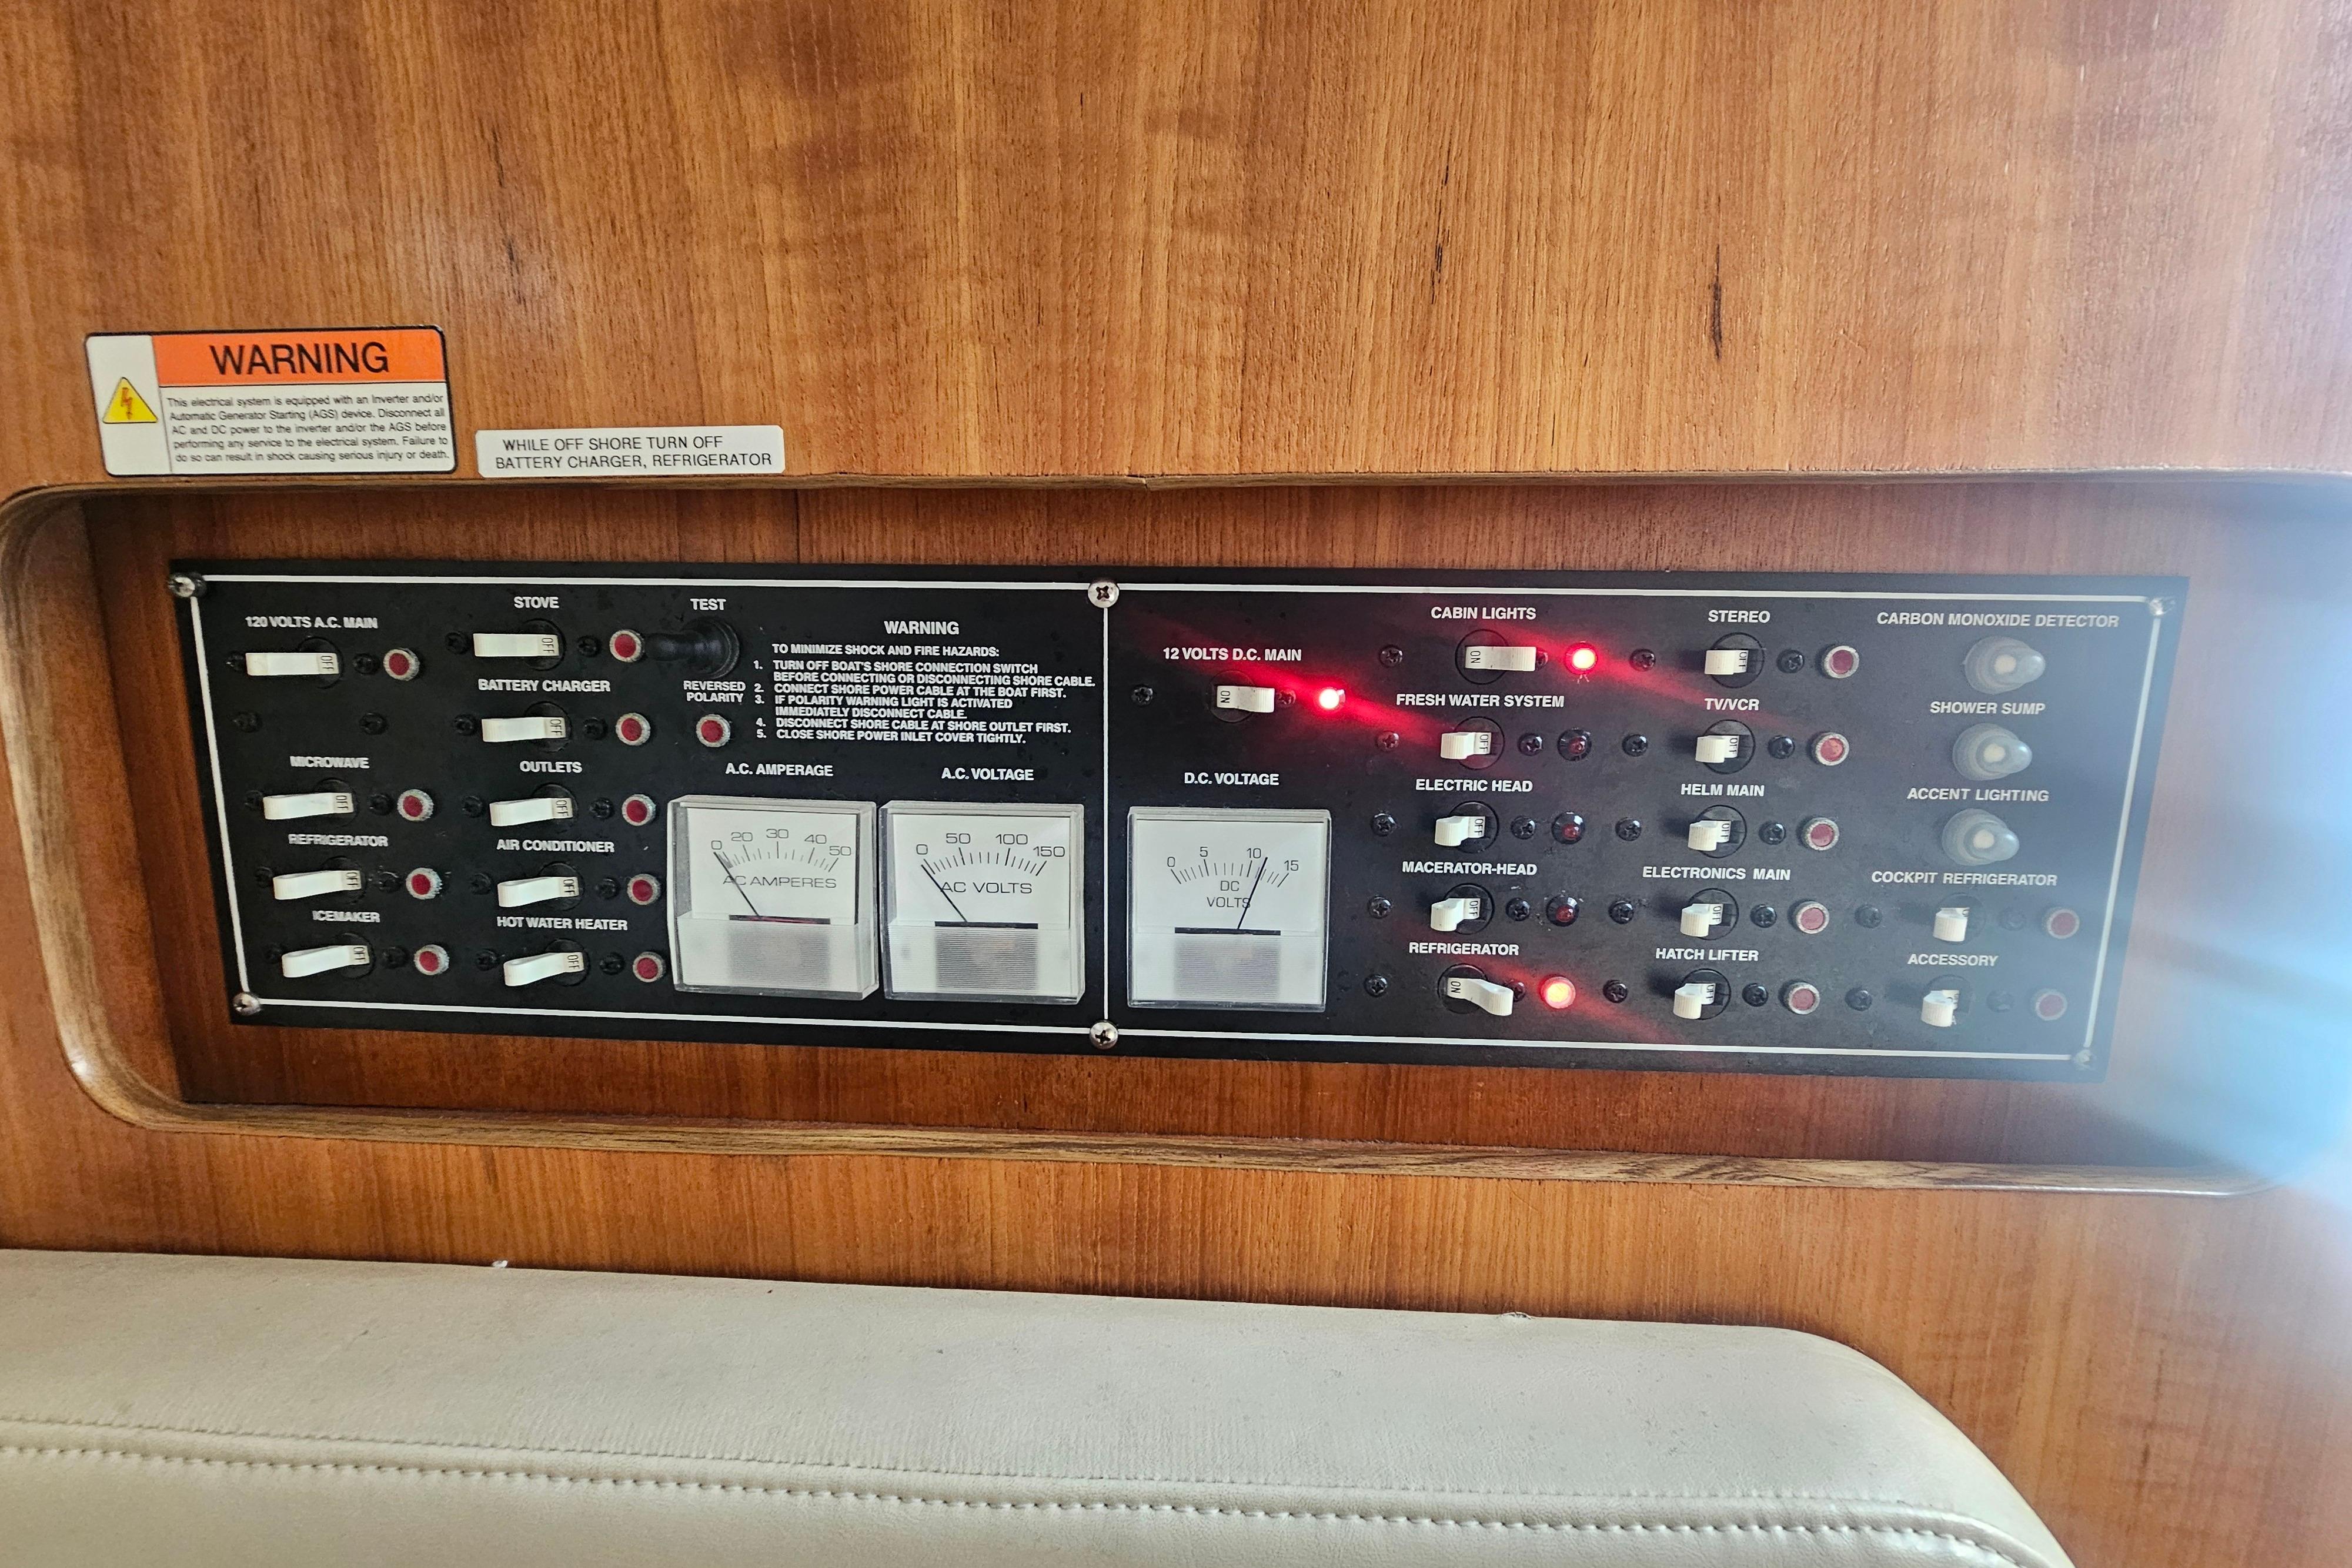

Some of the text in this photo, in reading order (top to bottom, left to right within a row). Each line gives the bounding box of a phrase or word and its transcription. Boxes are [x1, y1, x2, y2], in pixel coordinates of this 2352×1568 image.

[209, 341, 389, 375] WARNING
[166, 397, 188, 407] This
[191, 399, 233, 407] electrical
[236, 398, 270, 407] system
[285, 396, 330, 407] equipped
[333, 395, 353, 404] with
[412, 393, 444, 403] and/or
[503, 436, 723, 451] WHILE OFF SHORE TURN OFF
[496, 453, 772, 469] BATTERY CHARGER, REFRIGERATOR
[513, 596, 560, 609] STOVE
[690, 598, 727, 611] TEST
[1431, 606, 1536, 620] CABIN LIGHTS
[1708, 610, 1770, 623] STEREO
[1877, 612, 2119, 627] CARBON MONOXIDE DETECTOR
[245, 616, 378, 628] 120 VOLTS A.C. MAIN
[884, 621, 960, 635] WARNING
[771, 643, 1000, 657] TO MINIMIZE SHOCK AND FIRE HAZARDS:
[1163, 647, 1302, 661] 12 VOLTS D.C. MAIN
[1470, 650, 1481, 663] ON
[753, 660, 1038, 674] 1. TURN OFF BOAT'S SHORE CONNECTION SWITCH
[478, 678, 611, 692] BATTERY CHARGER
[683, 680, 746, 691] REVERSED
[774, 671, 1095, 687] BEFORE CONNECTING OR DISCONNECTING SHORE CABLE.
[754, 683, 1067, 698] 2. CONNECT SHORE POWER CABLE AT THE BOAT FIRST.
[1220, 690, 1231, 703] ON
[686, 692, 744, 703] POLARITY
[754, 694, 1013, 708] 3. IF POLARITY WARNING LIGHT IS ACTIVATED
[1396, 694, 1565, 707] FRESH WATER SYSTEM
[1704, 698, 1759, 711] TV/VCR
[1930, 701, 2046, 714] SHOWER SUMP
[775, 706, 967, 719] IMMEDIATELY DISCONNECT CABLE.
[756, 717, 1071, 733] 4. DISCONNECT SHORE CABLE AT SHORE OUTLET FIRST.
[756, 728, 1026, 744] 5. CLOSE SHORE POWER INLET COVER TIGHTLY.
[289, 755, 370, 769] MICROWAVE
[519, 761, 583, 773] OUTLETS
[725, 763, 834, 777] A.C. AMPERAGE
[941, 767, 1034, 781] A.C. VOLTAGE
[1184, 772, 1279, 785] D.C. VOLTAGE
[1415, 778, 1533, 792] ELECTRIC HEAD
[1681, 783, 1765, 797] HELM MAIN
[1906, 787, 2049, 801] ACCENT LIGHTING
[731, 831, 753, 842] 20
[766, 828, 789, 839] 30
[804, 834, 827, 844] 40
[946, 833, 971, 844] 50
[995, 834, 1028, 845] 100
[288, 834, 389, 847] REFRIGERATOR
[496, 839, 615, 852] AIR CONDITIONER
[711, 840, 723, 850] 0
[829, 845, 851, 856] 50
[916, 844, 928, 855] 0
[1033, 846, 1065, 857] 150
[1200, 846, 1208, 857] 5
[1247, 848, 1261, 859] 10
[1167, 856, 1175, 868] 0
[1284, 860, 1299, 871] 15
[1402, 861, 1538, 875] MACERATOR-HEAD
[1642, 866, 1791, 881] ELECTRONICS MAIN
[1871, 871, 2057, 886] COCKPIT REFRIGERATOR
[723, 875, 837, 888] AC AMPERES
[941, 882, 1032, 894] AC VOLTS
[1220, 880, 1240, 892] DC
[1207, 897, 1251, 908] VOLTS
[312, 910, 380, 923] ICEMAKER
[497, 916, 628, 931] HOT WATER HEATER
[1409, 942, 1519, 955] REFRIGERATOR
[1656, 948, 1759, 961] HATCH LIFTER
[1907, 954, 1999, 967] ACCESSORY
[1451, 981, 1461, 994] ON
